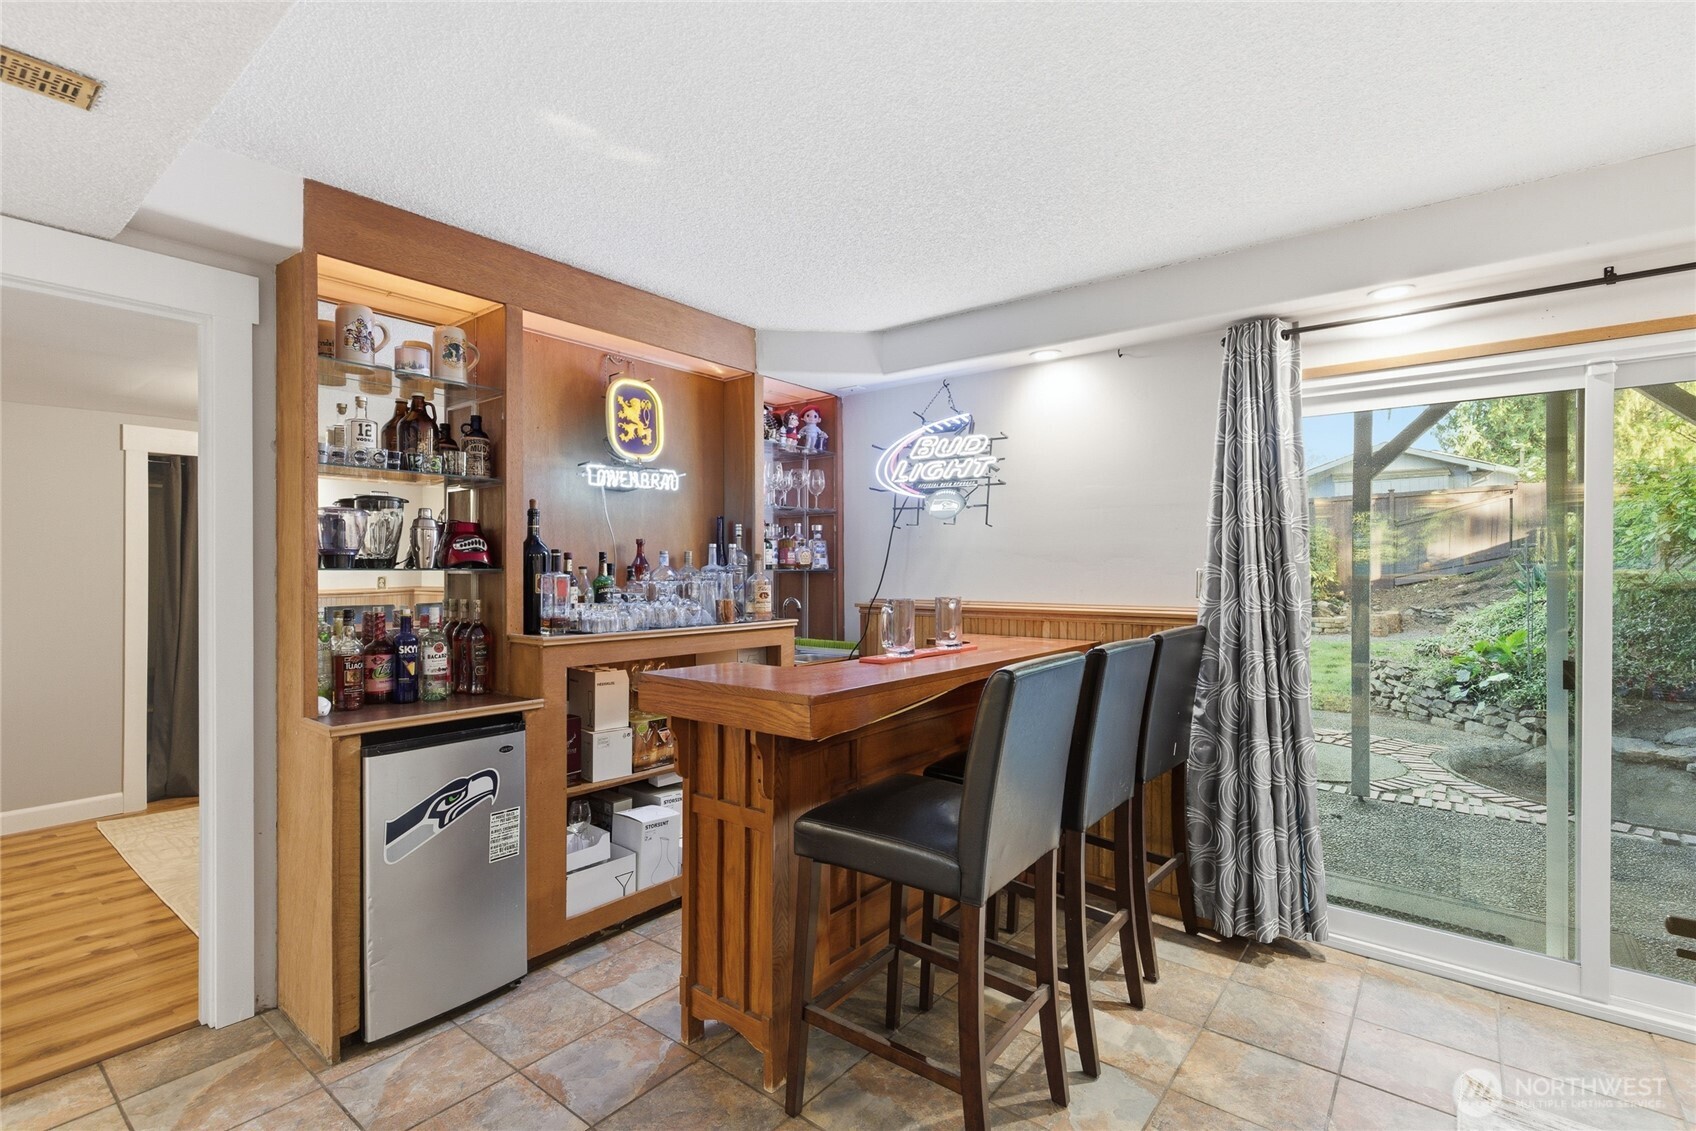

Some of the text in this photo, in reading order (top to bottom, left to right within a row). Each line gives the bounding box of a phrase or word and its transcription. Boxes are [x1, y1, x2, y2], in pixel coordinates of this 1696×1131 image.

[358, 423, 372, 437] 12
[470, 445, 487, 453] MUD
[909, 434, 989, 459] BUD
[891, 456, 997, 483] LIGHT
[645, 820, 669, 831] STORSINT
